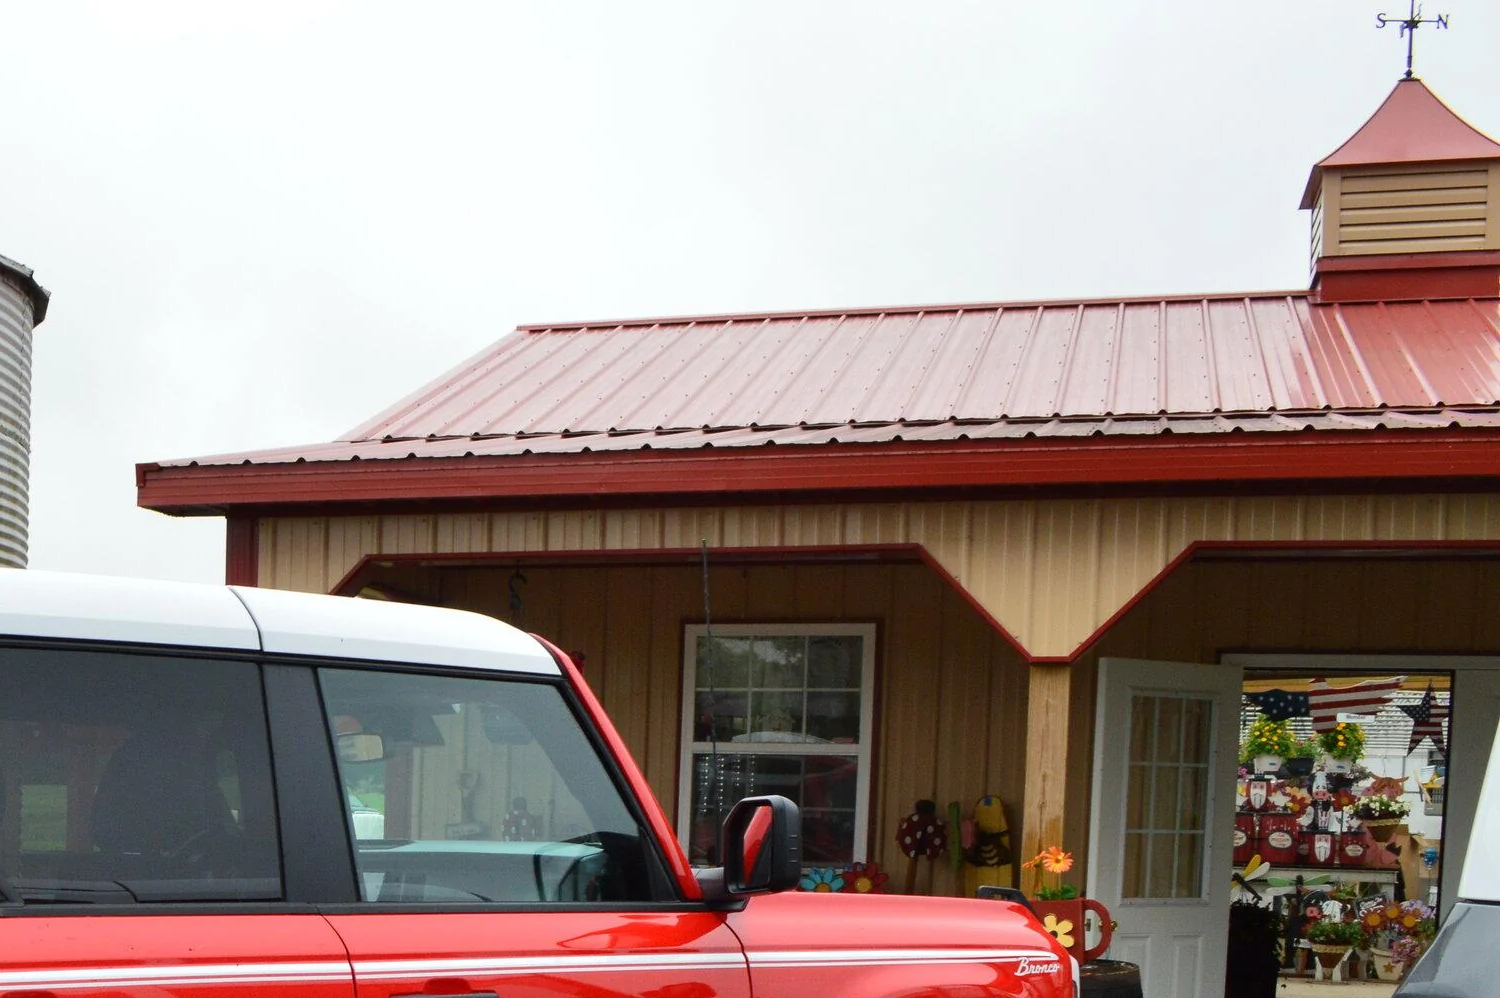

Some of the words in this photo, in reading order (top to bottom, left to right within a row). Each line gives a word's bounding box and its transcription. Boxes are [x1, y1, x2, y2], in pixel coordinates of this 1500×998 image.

[1376, 13, 1387, 29] S
[1437, 14, 1449, 29] N
[1014, 957, 1060, 976] Bronco
